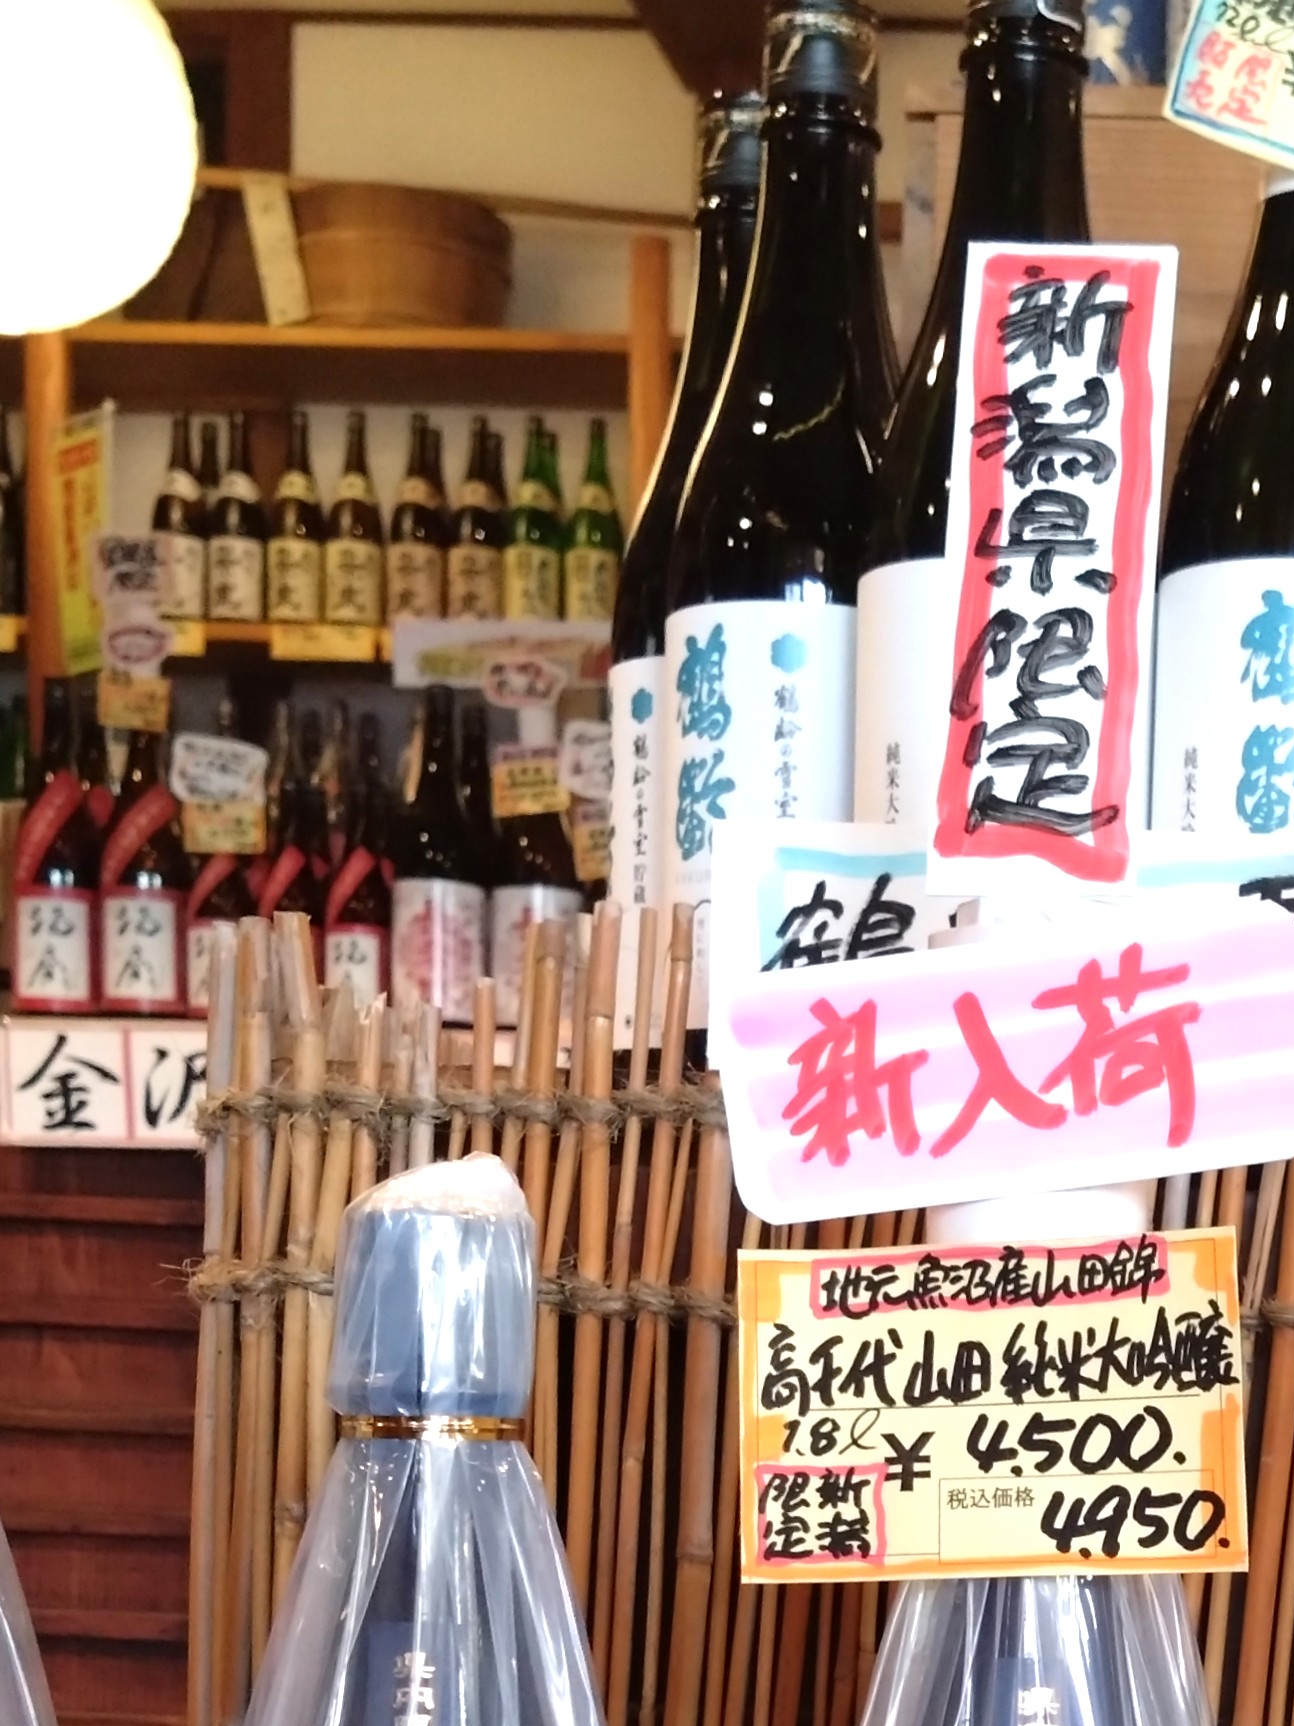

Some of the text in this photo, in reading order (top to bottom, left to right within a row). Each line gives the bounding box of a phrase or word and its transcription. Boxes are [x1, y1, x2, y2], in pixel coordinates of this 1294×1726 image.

[950, 264, 1133, 834] 新潟県限定
[885, 742, 901, 825] 純米大
[781, 942, 1201, 1166] 新入荷
[946, 1489, 1035, 1509] 税込価格
